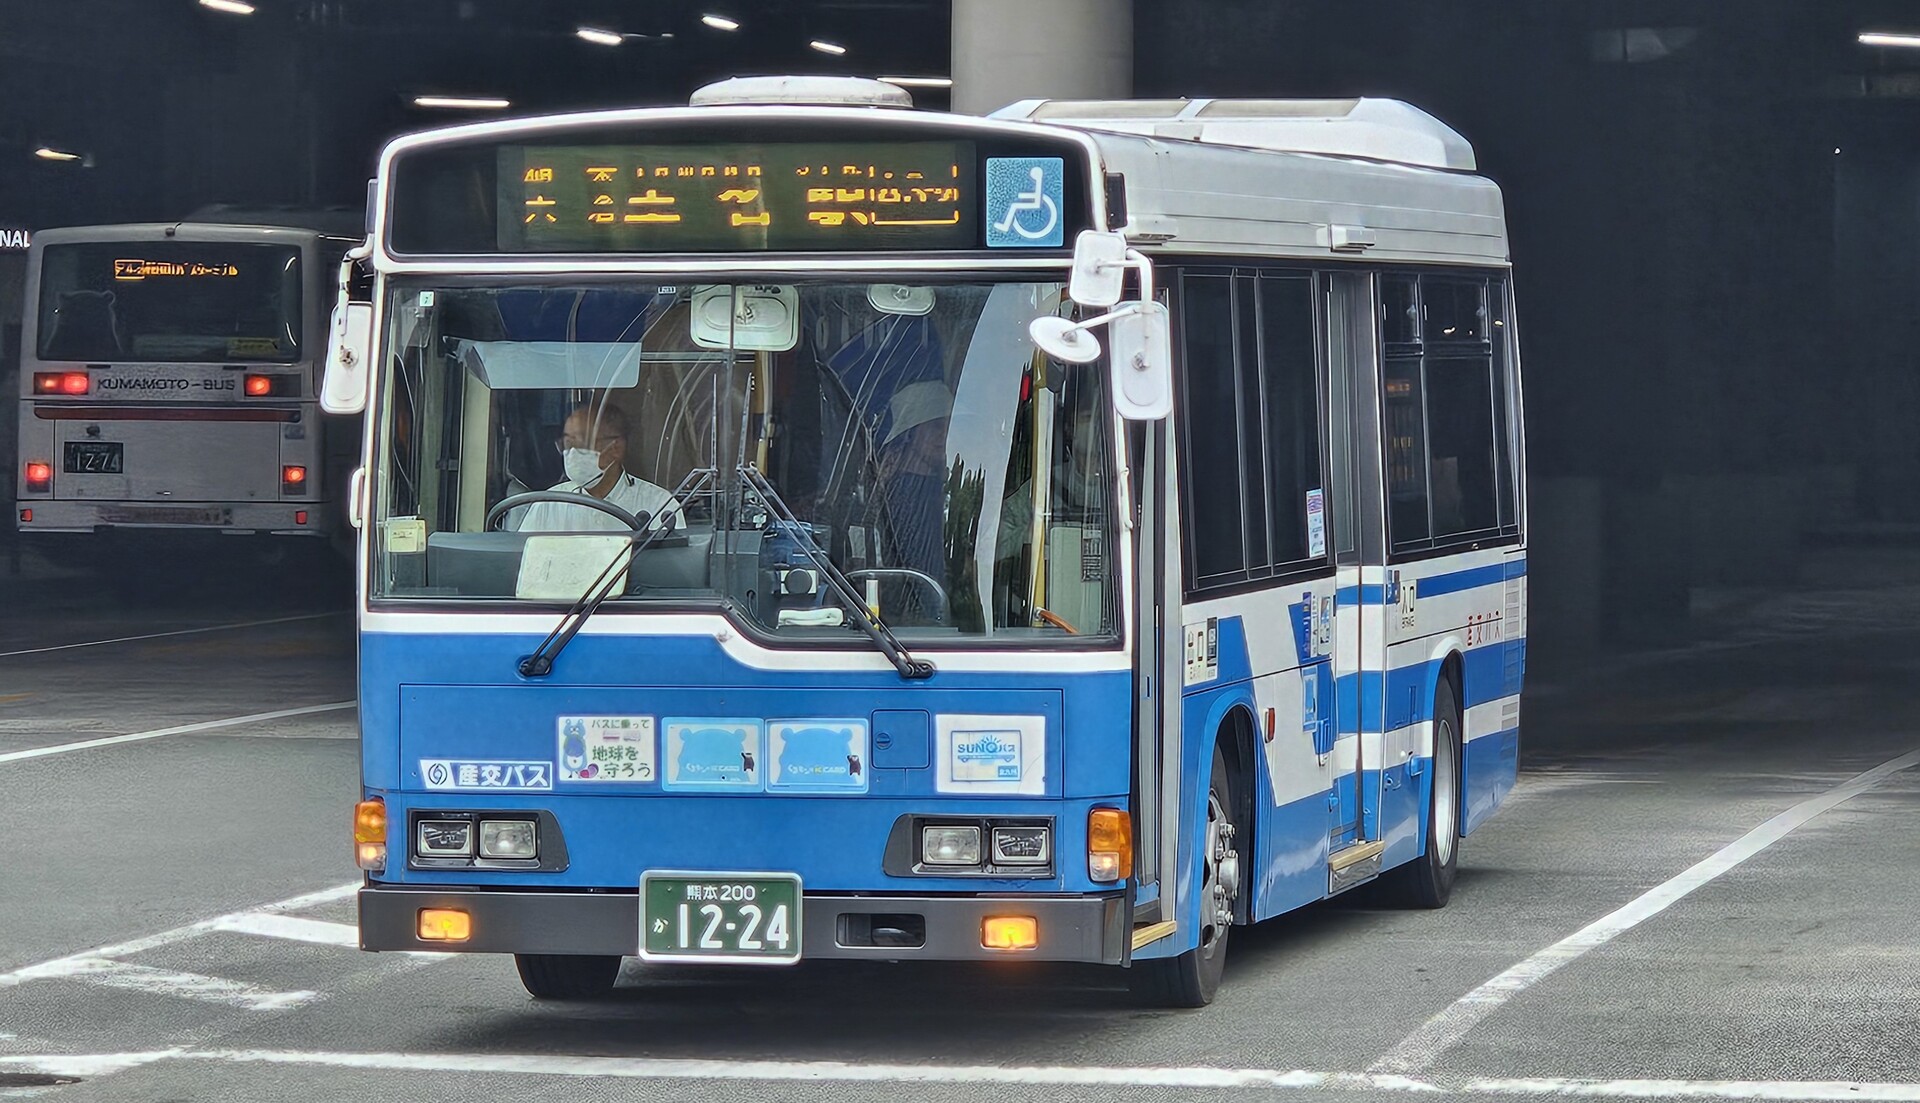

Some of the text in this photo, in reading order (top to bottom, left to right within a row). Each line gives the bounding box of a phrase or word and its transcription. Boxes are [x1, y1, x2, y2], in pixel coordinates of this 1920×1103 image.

[592, 745, 640, 762] 地球を
[457, 764, 549, 788] 産交バス
[604, 762, 651, 778] 守ろう
[652, 903, 790, 950] か 12-24
